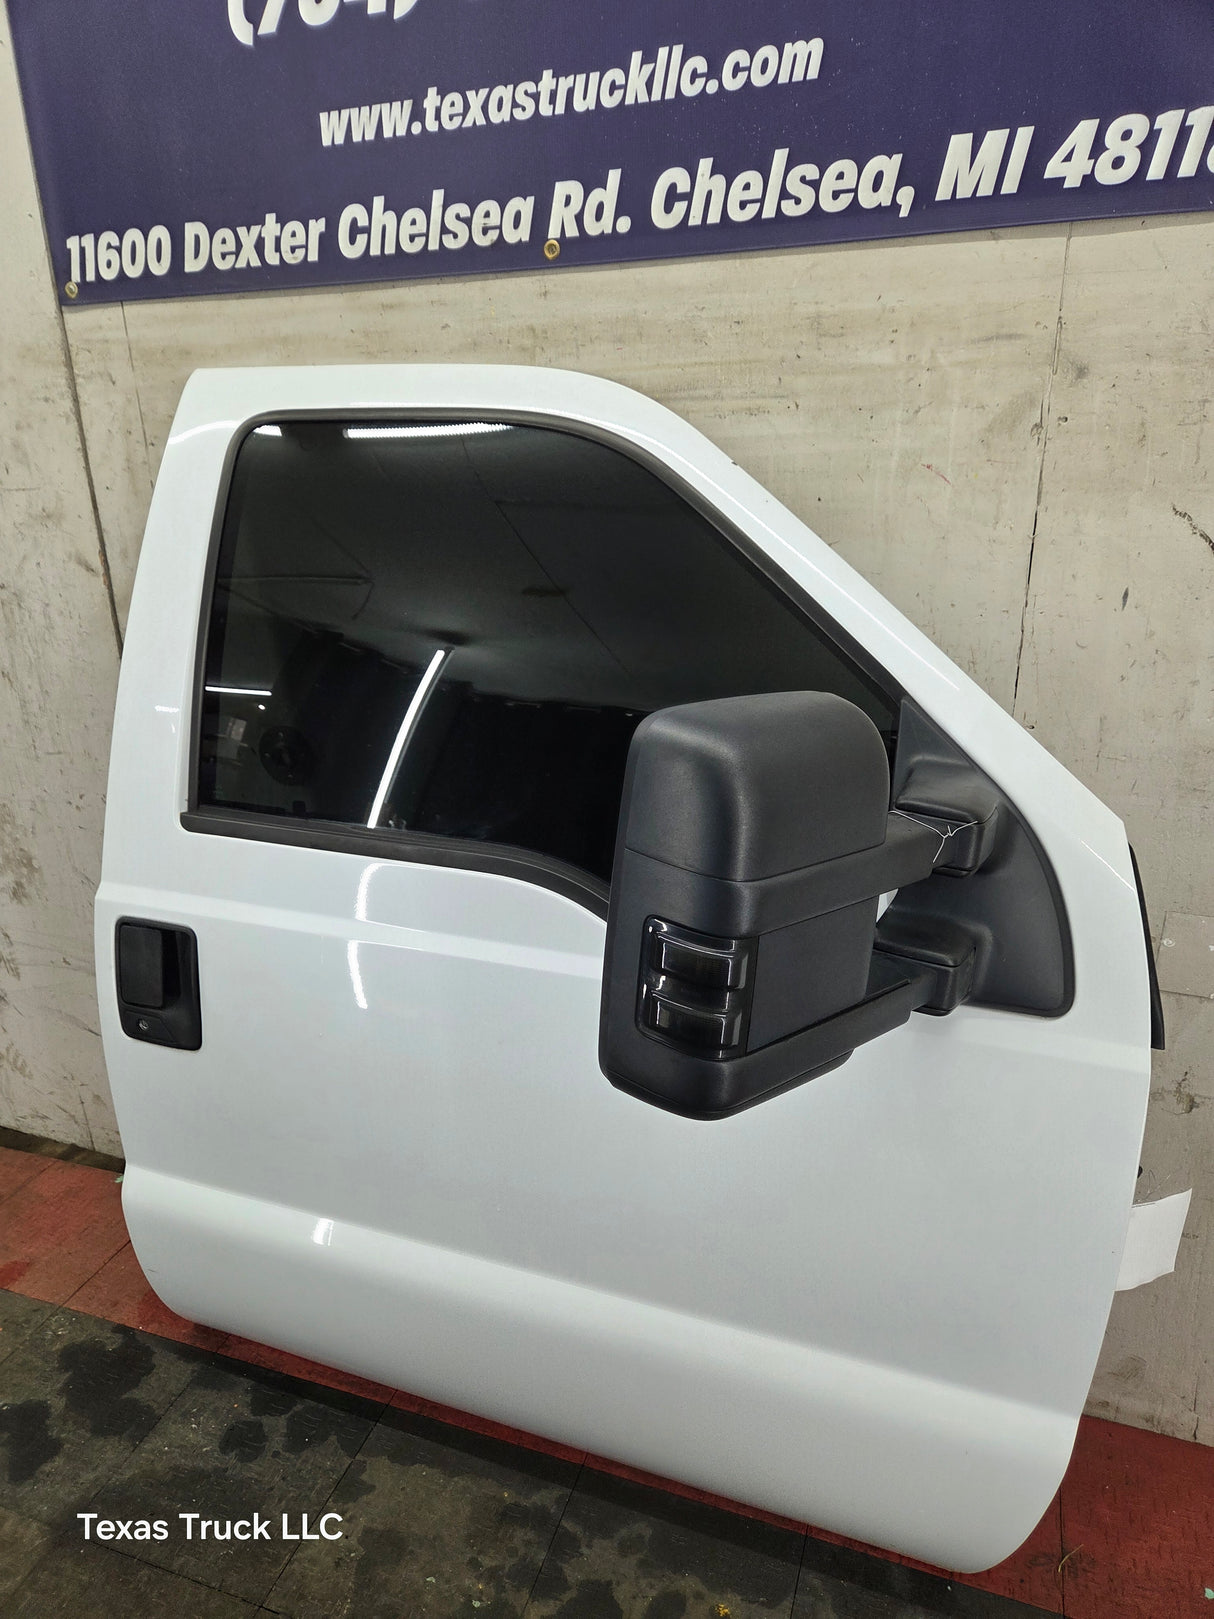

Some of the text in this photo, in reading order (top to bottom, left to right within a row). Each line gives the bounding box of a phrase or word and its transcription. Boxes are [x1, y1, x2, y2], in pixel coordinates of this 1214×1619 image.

[319, 37, 824, 147] www.texastruckllc.com
[66, 105, 1214, 283] 11600 Dexter Chelsea Rd. Chelsea, MI 4811
